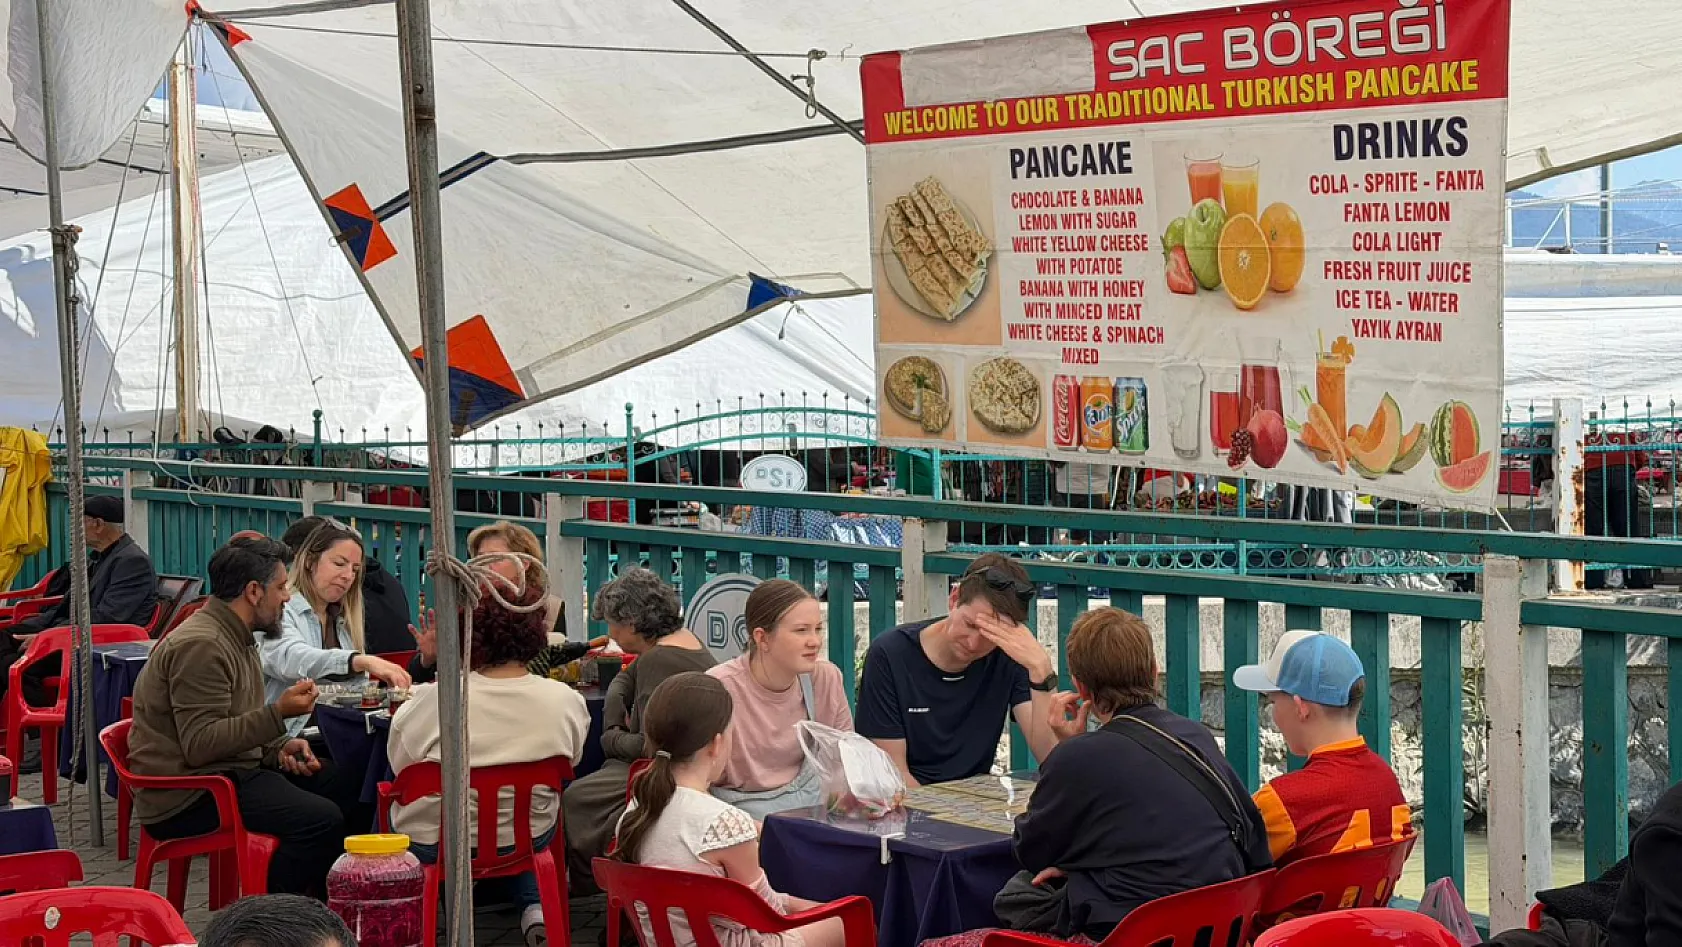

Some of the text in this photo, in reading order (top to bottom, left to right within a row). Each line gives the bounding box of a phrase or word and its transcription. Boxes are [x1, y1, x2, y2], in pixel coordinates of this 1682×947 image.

[1107, 31, 1206, 82] SAC
[884, 59, 1480, 136] WELCOME TO OUR TRADITIONAL TURKISH PANCAKE
[1333, 116, 1468, 161] DRINKS
[1010, 141, 1132, 179] PANCAKE
[1309, 174, 1349, 195] COLA
[1365, 171, 1418, 193] SPRITE
[1436, 169, 1484, 191] FANTA
[1011, 187, 1144, 209] CHOCOLATE & BANANA
[1019, 211, 1138, 231] LEMON WITH SUGAR
[1344, 201, 1451, 223] FANTA LEMON
[1012, 234, 1149, 253] WHITE YELLOW CHEESE
[1352, 232, 1443, 253] COLA LIGHT
[1036, 257, 1123, 275] WITH POTATOE
[1324, 261, 1472, 283] FRESH FRUIT JUICE
[1020, 280, 1145, 298] BANANA WITH HONEY
[1024, 302, 1142, 321] WITH MINCED MEAT
[1336, 290, 1360, 309] ICE
[1366, 290, 1391, 310] TEA
[1408, 292, 1459, 313] WATER
[1008, 323, 1164, 344] WHITE CHEESE & SPINACH
[1352, 319, 1443, 342] YAYIK AYRAN
[1061, 347, 1099, 364] MIXED
